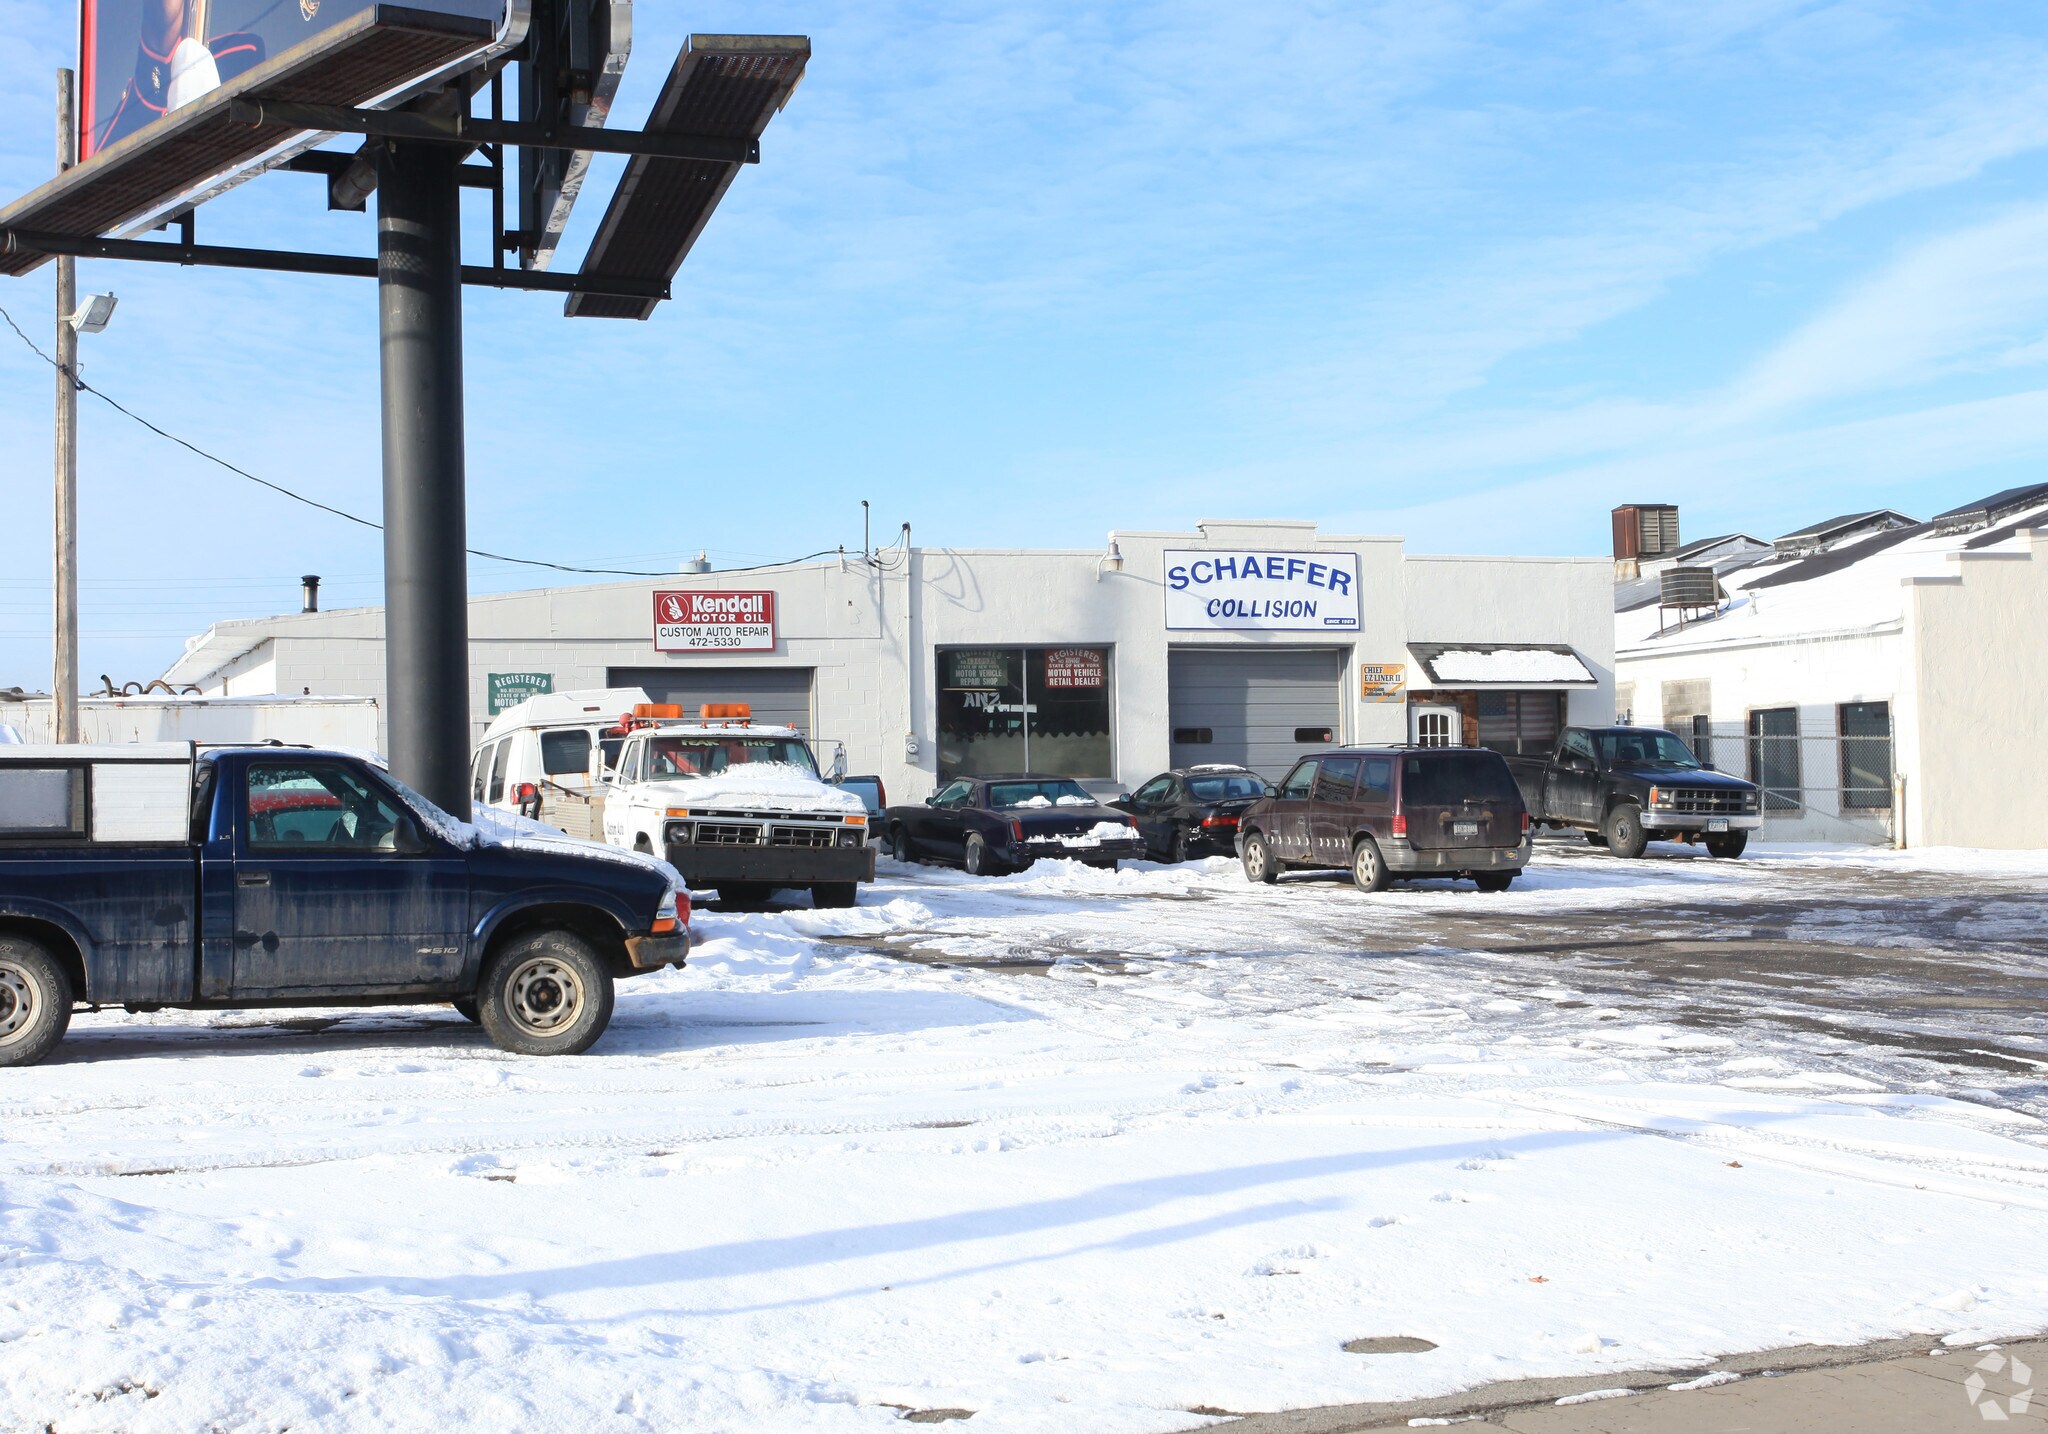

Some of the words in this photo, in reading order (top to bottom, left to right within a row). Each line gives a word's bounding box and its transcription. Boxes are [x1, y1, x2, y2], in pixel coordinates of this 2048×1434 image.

[1168, 556, 1352, 596] SCHAEFER
[692, 595, 764, 613] Kendall
[1207, 599, 1317, 618] COLLISION
[692, 613, 736, 622] MOTOR
[743, 613, 764, 622] OIL
[660, 627, 702, 637] CUSTOM
[706, 627, 731, 637] AUTO
[736, 627, 769, 636] REPAIR
[689, 637, 741, 647] 472-5330
[1049, 649, 1100, 662] REGISTERED
[956, 669, 976, 677] MOTOR
[979, 669, 1002, 677] VEHICLE
[1048, 669, 1071, 677] MOTOR
[495, 674, 547, 688] REGISTERED
[960, 678, 980, 686] REPAIR
[982, 677, 998, 685] SHOP
[494, 698, 518, 707] MOTOR
